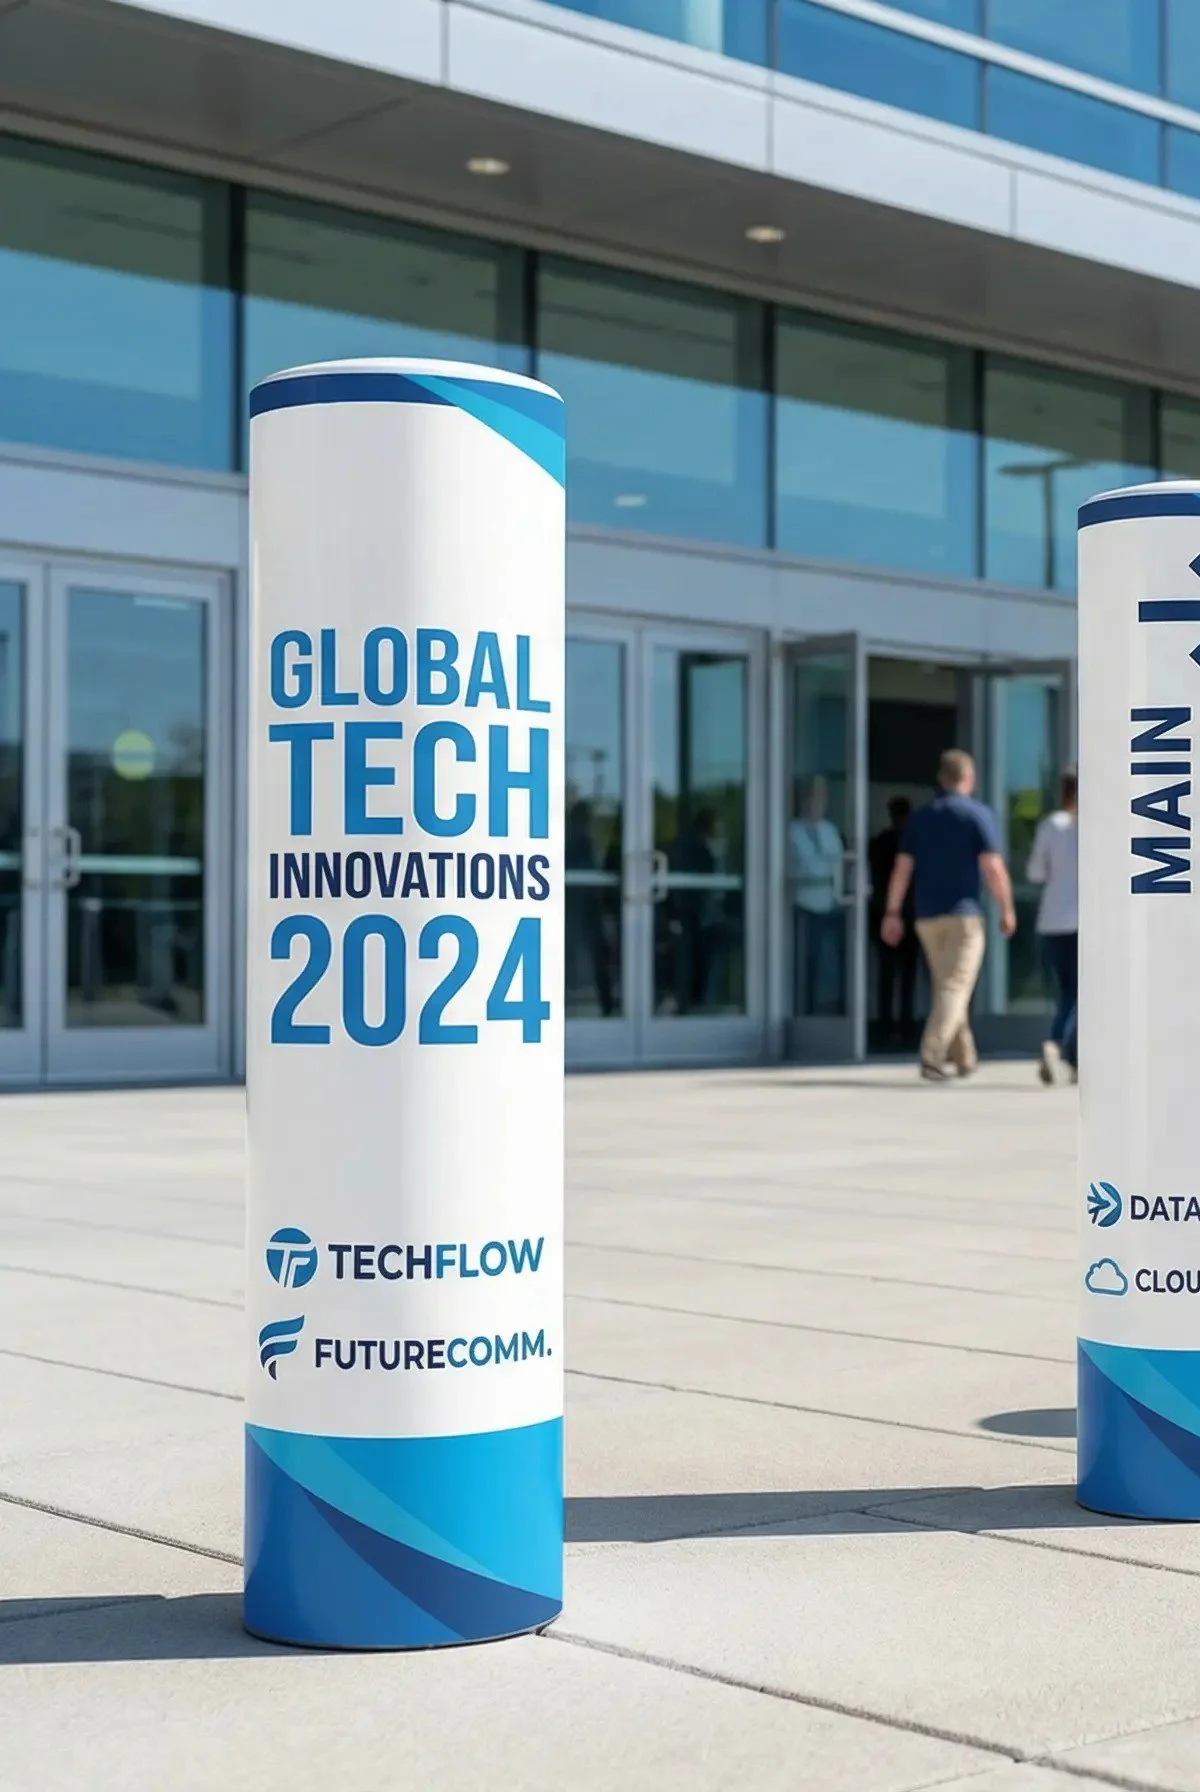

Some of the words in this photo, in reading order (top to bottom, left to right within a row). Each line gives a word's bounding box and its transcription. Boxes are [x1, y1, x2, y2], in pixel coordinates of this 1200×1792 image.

[270, 626, 551, 714] GLOBAL
[268, 720, 550, 840] TECH
[1130, 706, 1192, 895] MAIN
[269, 850, 551, 901] INNOVATIONS
[270, 913, 551, 1048] 2024
[327, 1236, 545, 1281] TECHFLOW
[315, 1328, 552, 1371] FUTURECOMM.
